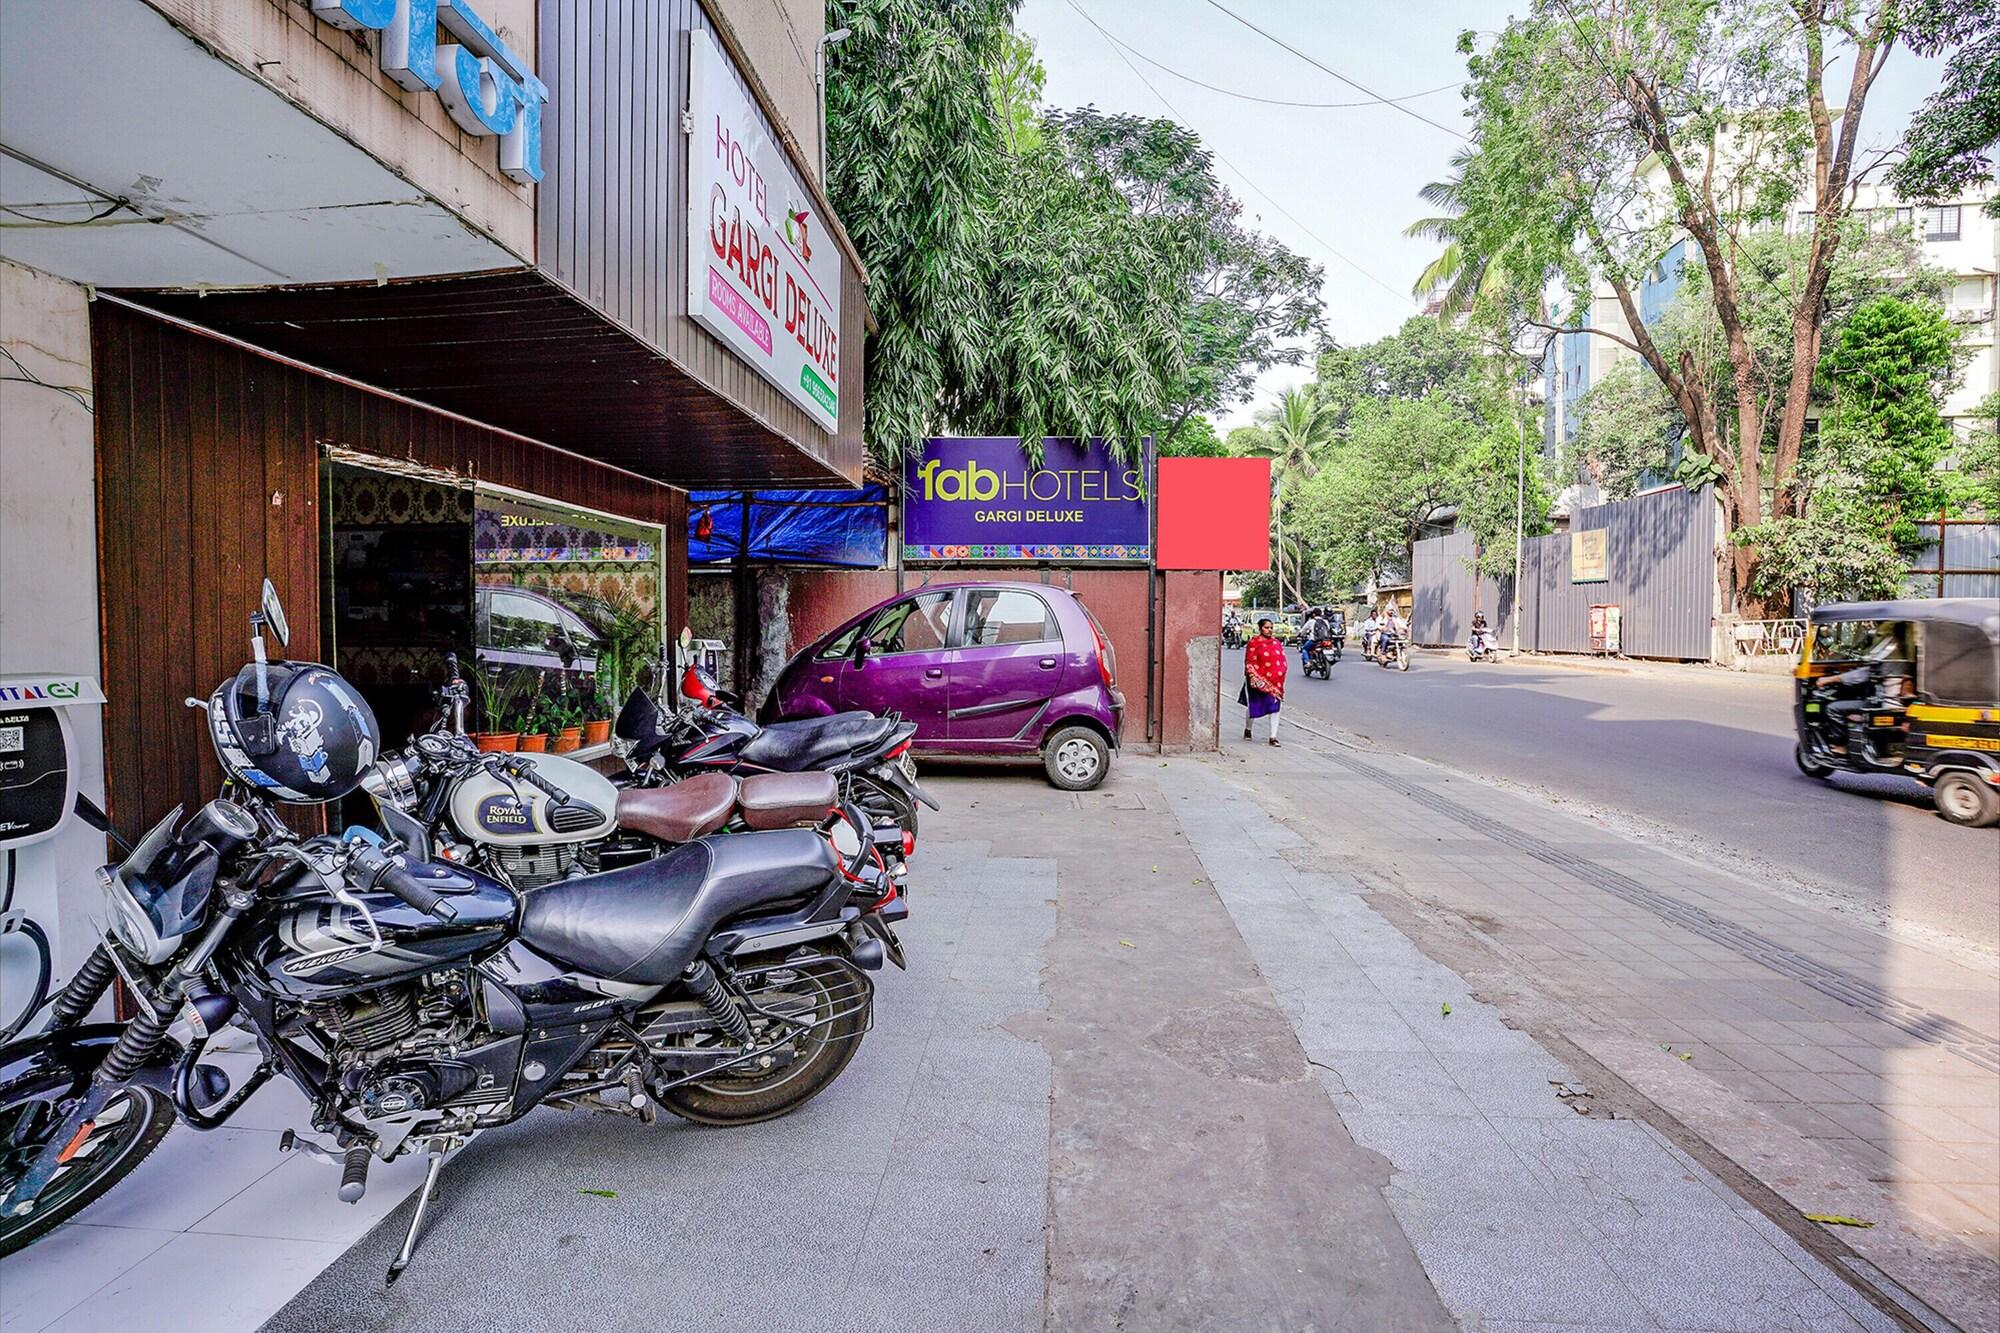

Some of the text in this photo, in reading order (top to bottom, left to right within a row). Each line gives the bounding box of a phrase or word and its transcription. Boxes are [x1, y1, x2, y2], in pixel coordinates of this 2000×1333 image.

[716, 114, 770, 227] HOTEL
[710, 182, 779, 319] GARGI
[784, 271, 837, 383] DELUXE
[711, 275, 769, 348] ROOMS AVAILABLE
[974, 510, 1084, 523] GARGI DELUXE
[487, 815, 527, 825] ENFIELD
[490, 805, 522, 816] ROYAL
